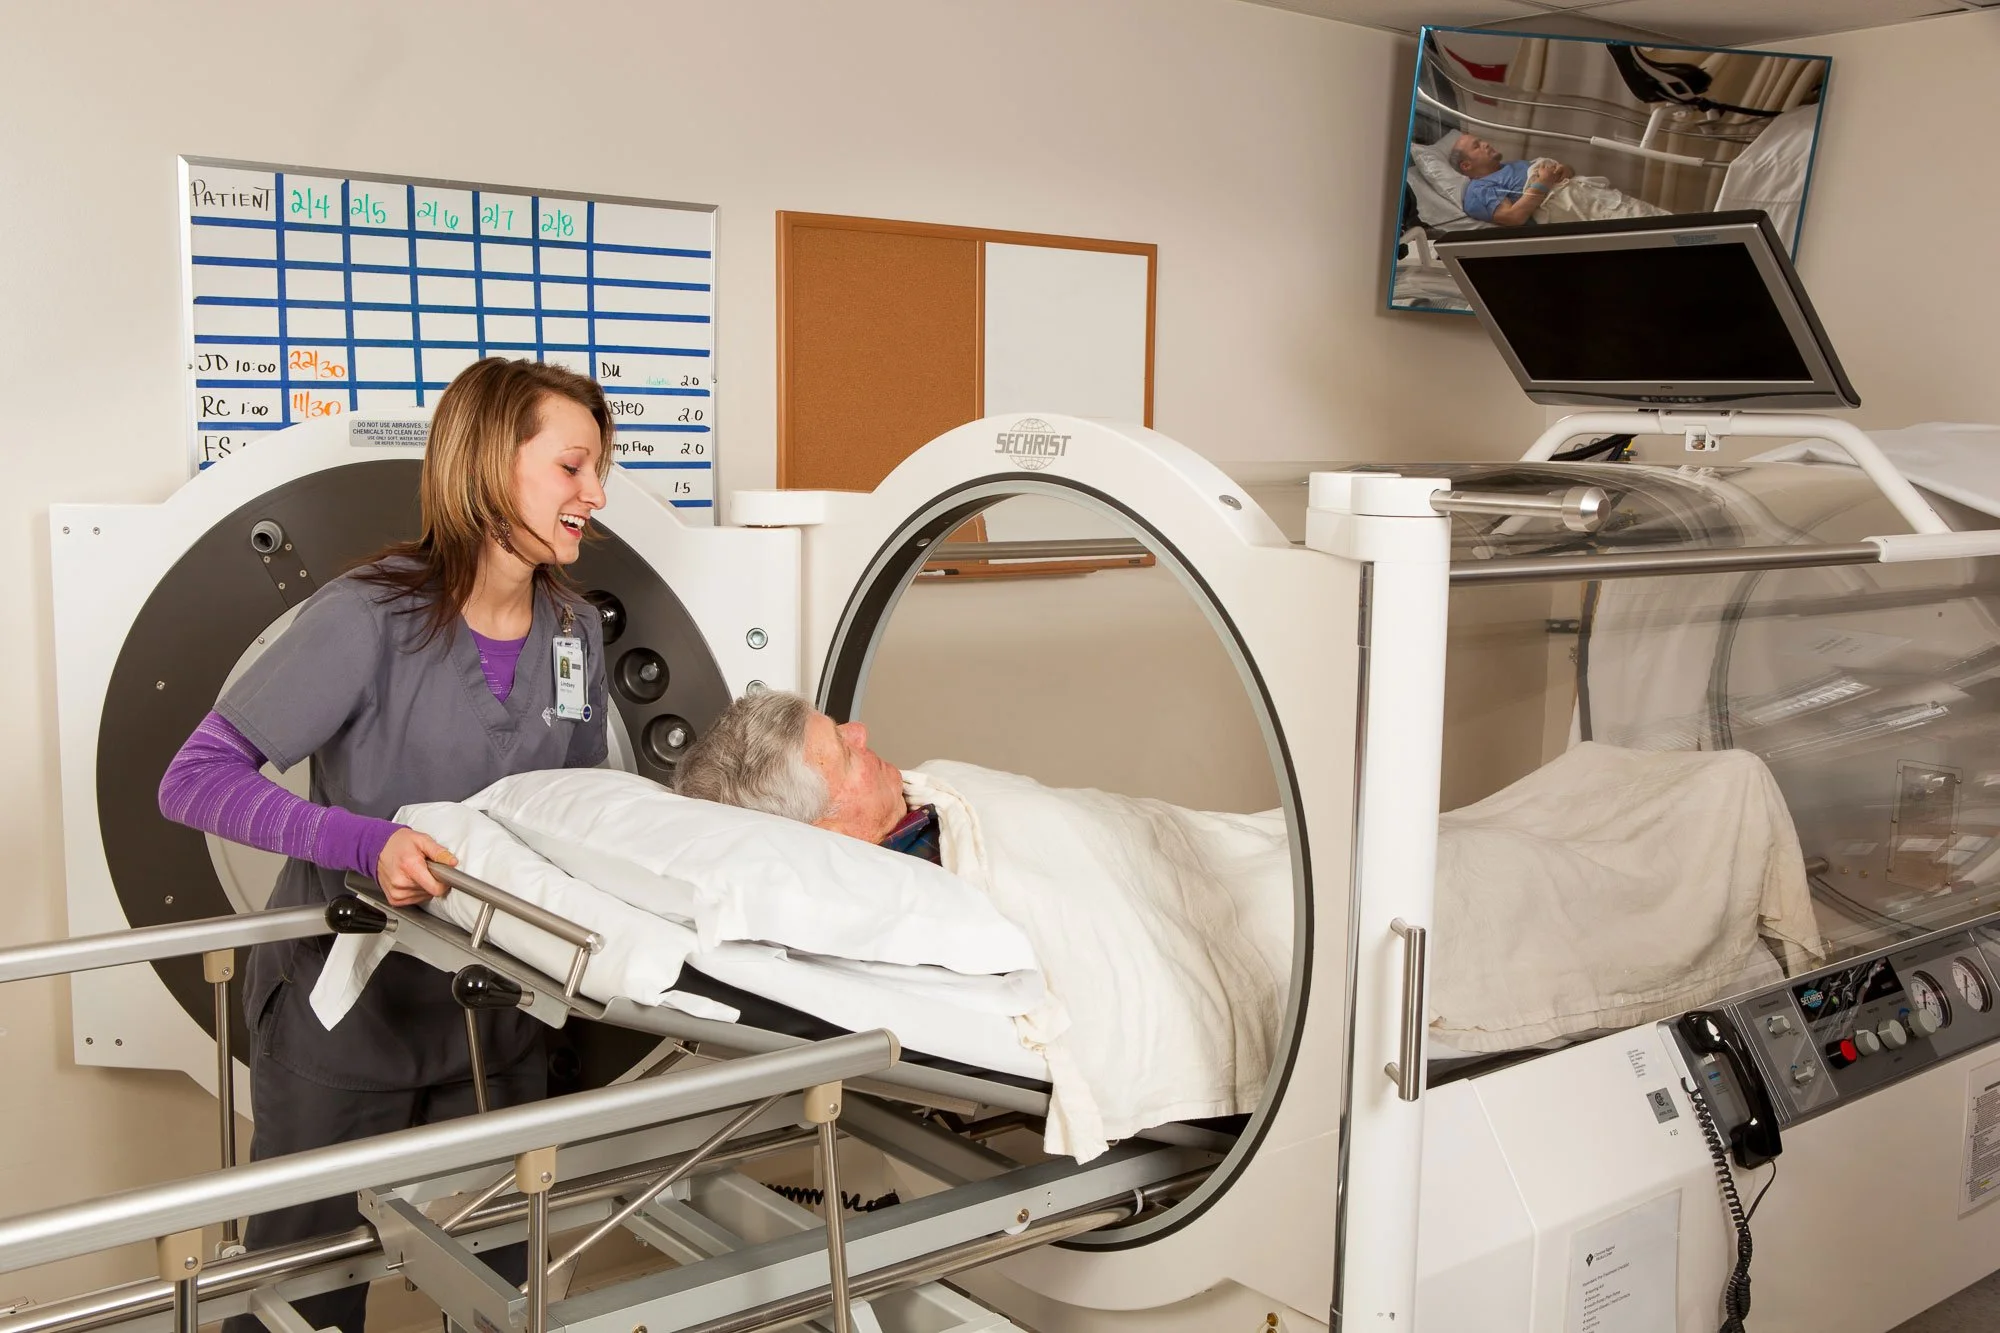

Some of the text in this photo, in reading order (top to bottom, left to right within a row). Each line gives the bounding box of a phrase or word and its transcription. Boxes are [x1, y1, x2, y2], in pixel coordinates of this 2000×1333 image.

[291, 188, 330, 219] 2/4
[350, 194, 386, 224] 2/5
[416, 201, 459, 231] 2/6
[481, 204, 514, 231] 2/7
[541, 209, 575, 238] 2/8
[198, 353, 277, 374] JD 10:00
[289, 350, 346, 380] 22/30
[200, 395, 269, 418] RC 1:00
[994, 432, 1072, 457] SECHRIST
[1800, 991, 1825, 1006] SECHRIST
